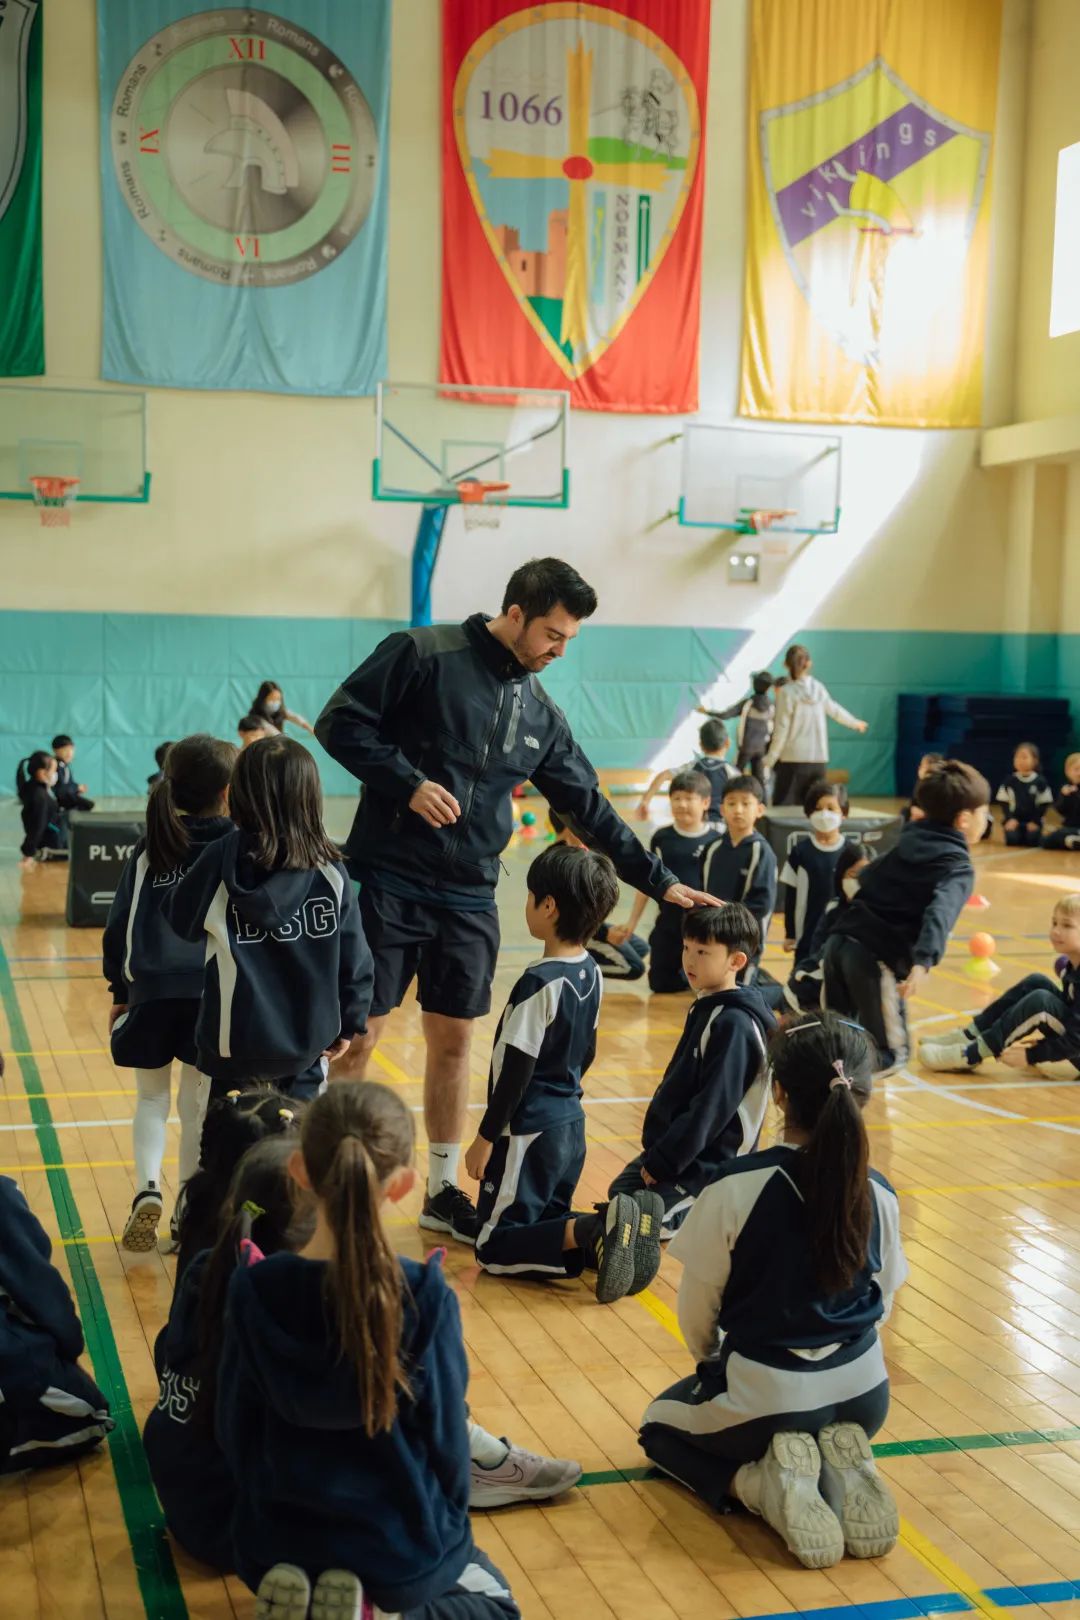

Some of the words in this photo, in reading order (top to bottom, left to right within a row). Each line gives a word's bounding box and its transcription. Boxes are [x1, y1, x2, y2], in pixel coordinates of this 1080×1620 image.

[228, 37, 266, 60] XII
[267, 18, 320, 57] Romans
[116, 63, 148, 118] Romans
[481, 90, 562, 126] 1066
[331, 143, 352, 174] III
[121, 160, 150, 219] Romans
[177, 247, 231, 280] Romans
